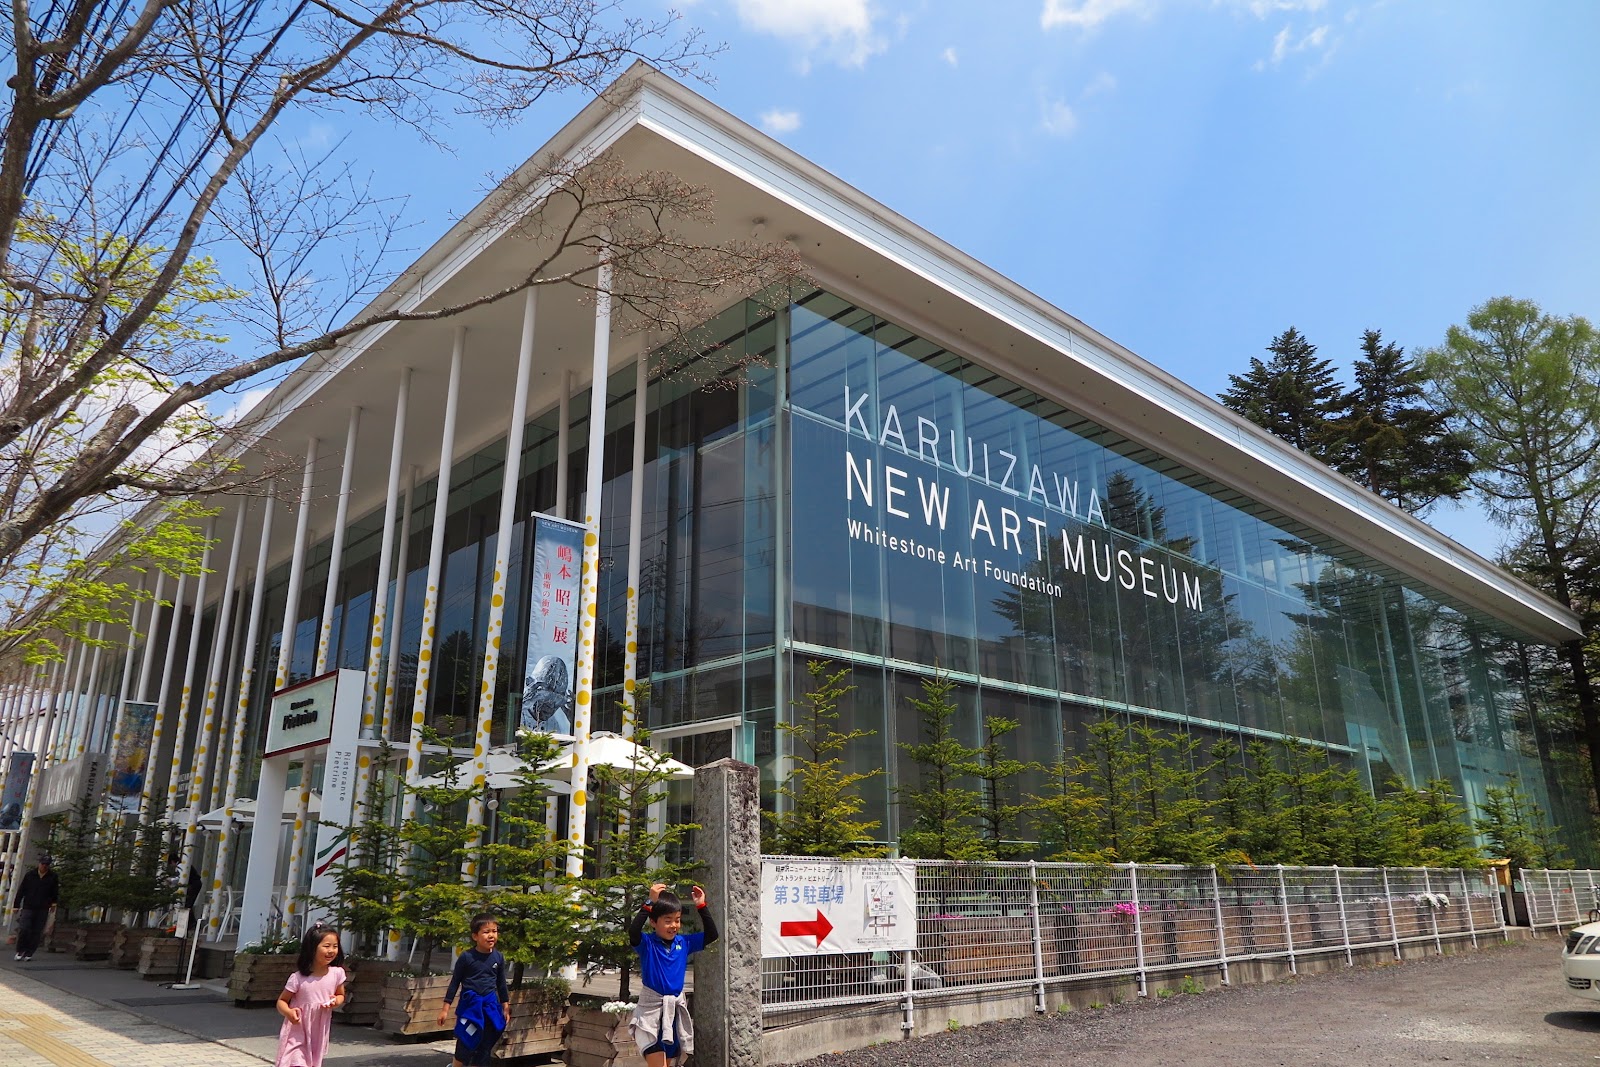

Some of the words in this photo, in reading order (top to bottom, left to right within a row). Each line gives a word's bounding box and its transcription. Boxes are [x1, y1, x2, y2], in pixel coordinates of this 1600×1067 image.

[844, 385, 1107, 529] KARUIZAWA
[845, 451, 950, 531] NEW
[970, 498, 1047, 562] ART
[1062, 528, 1203, 613] MUSEUM
[847, 518, 946, 565] Whitestone
[953, 551, 977, 574] Art
[984, 560, 1063, 598] Foundation
[552, 588, 571, 645] 昭三展
[339, 751, 352, 802] Ristorante
